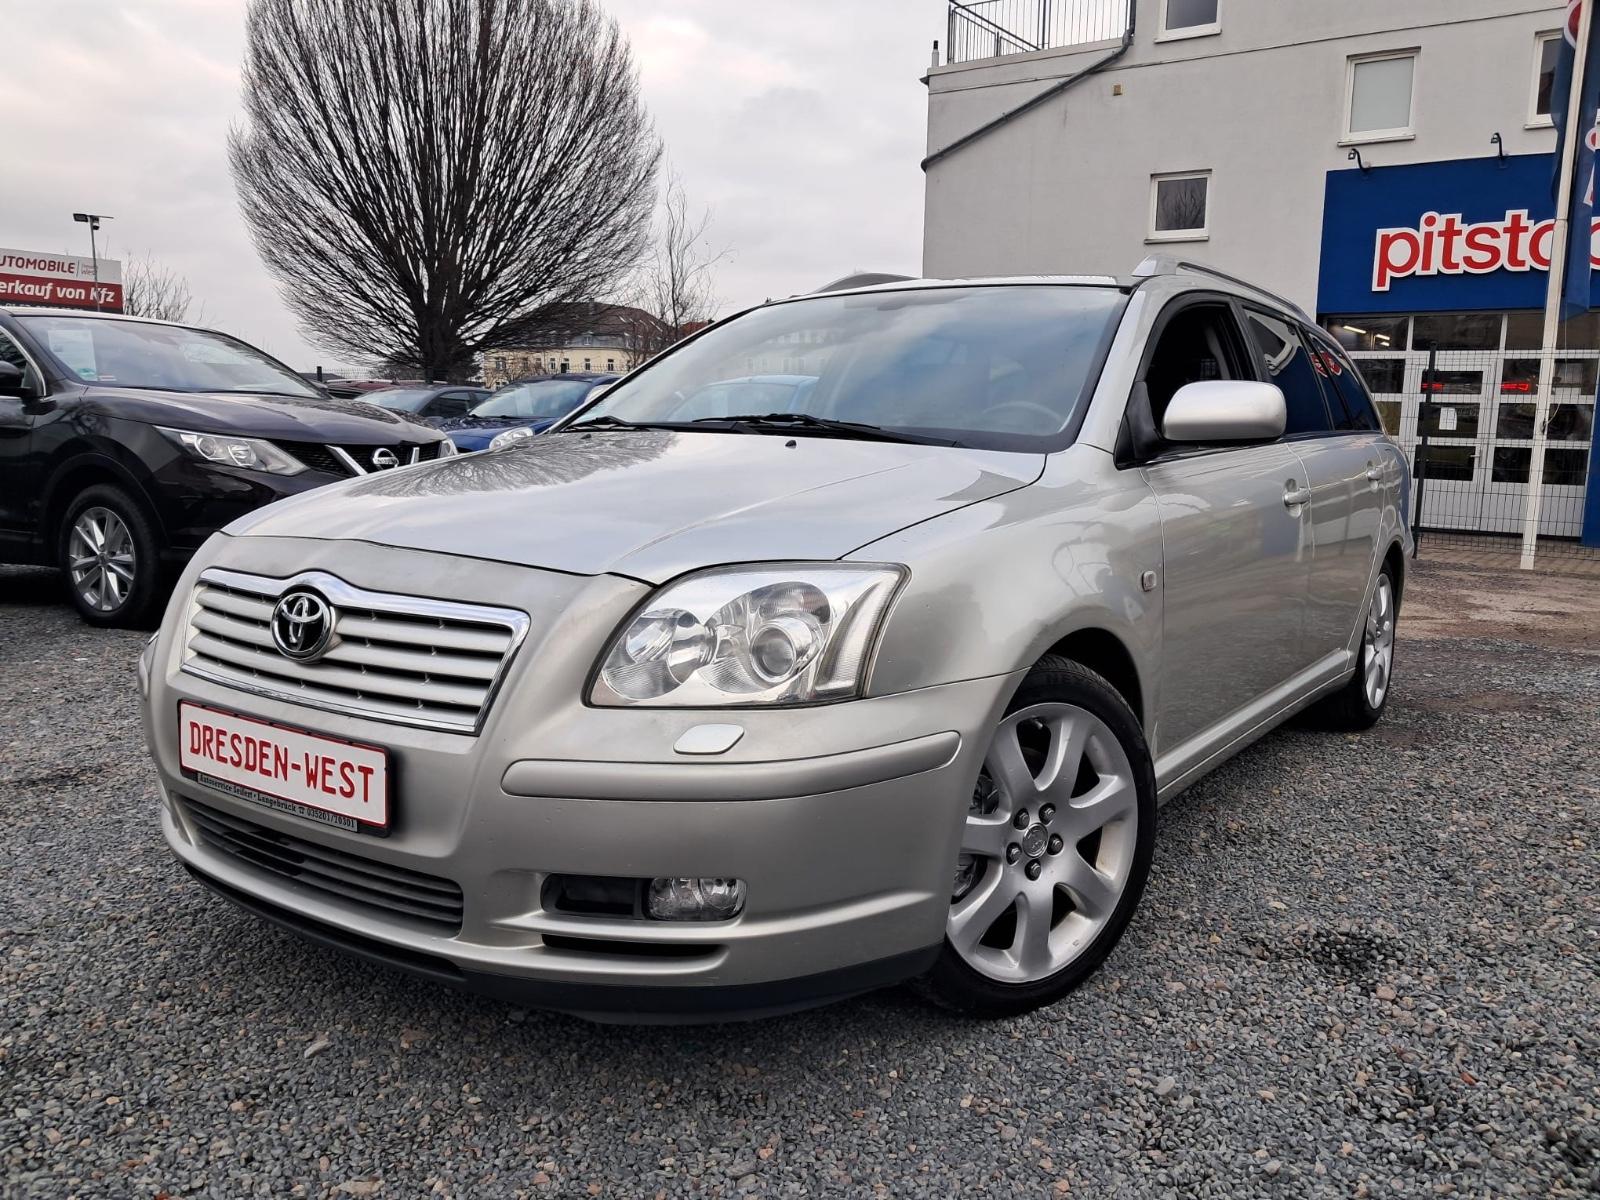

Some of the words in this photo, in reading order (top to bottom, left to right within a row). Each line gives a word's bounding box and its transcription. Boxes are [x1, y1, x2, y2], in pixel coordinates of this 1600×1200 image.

[56, 286, 86, 300] von
[90, 287, 116, 304] Kfz
[189, 720, 375, 803] DRESDEN-WEST
[200, 774, 233, 791] Autoservice
